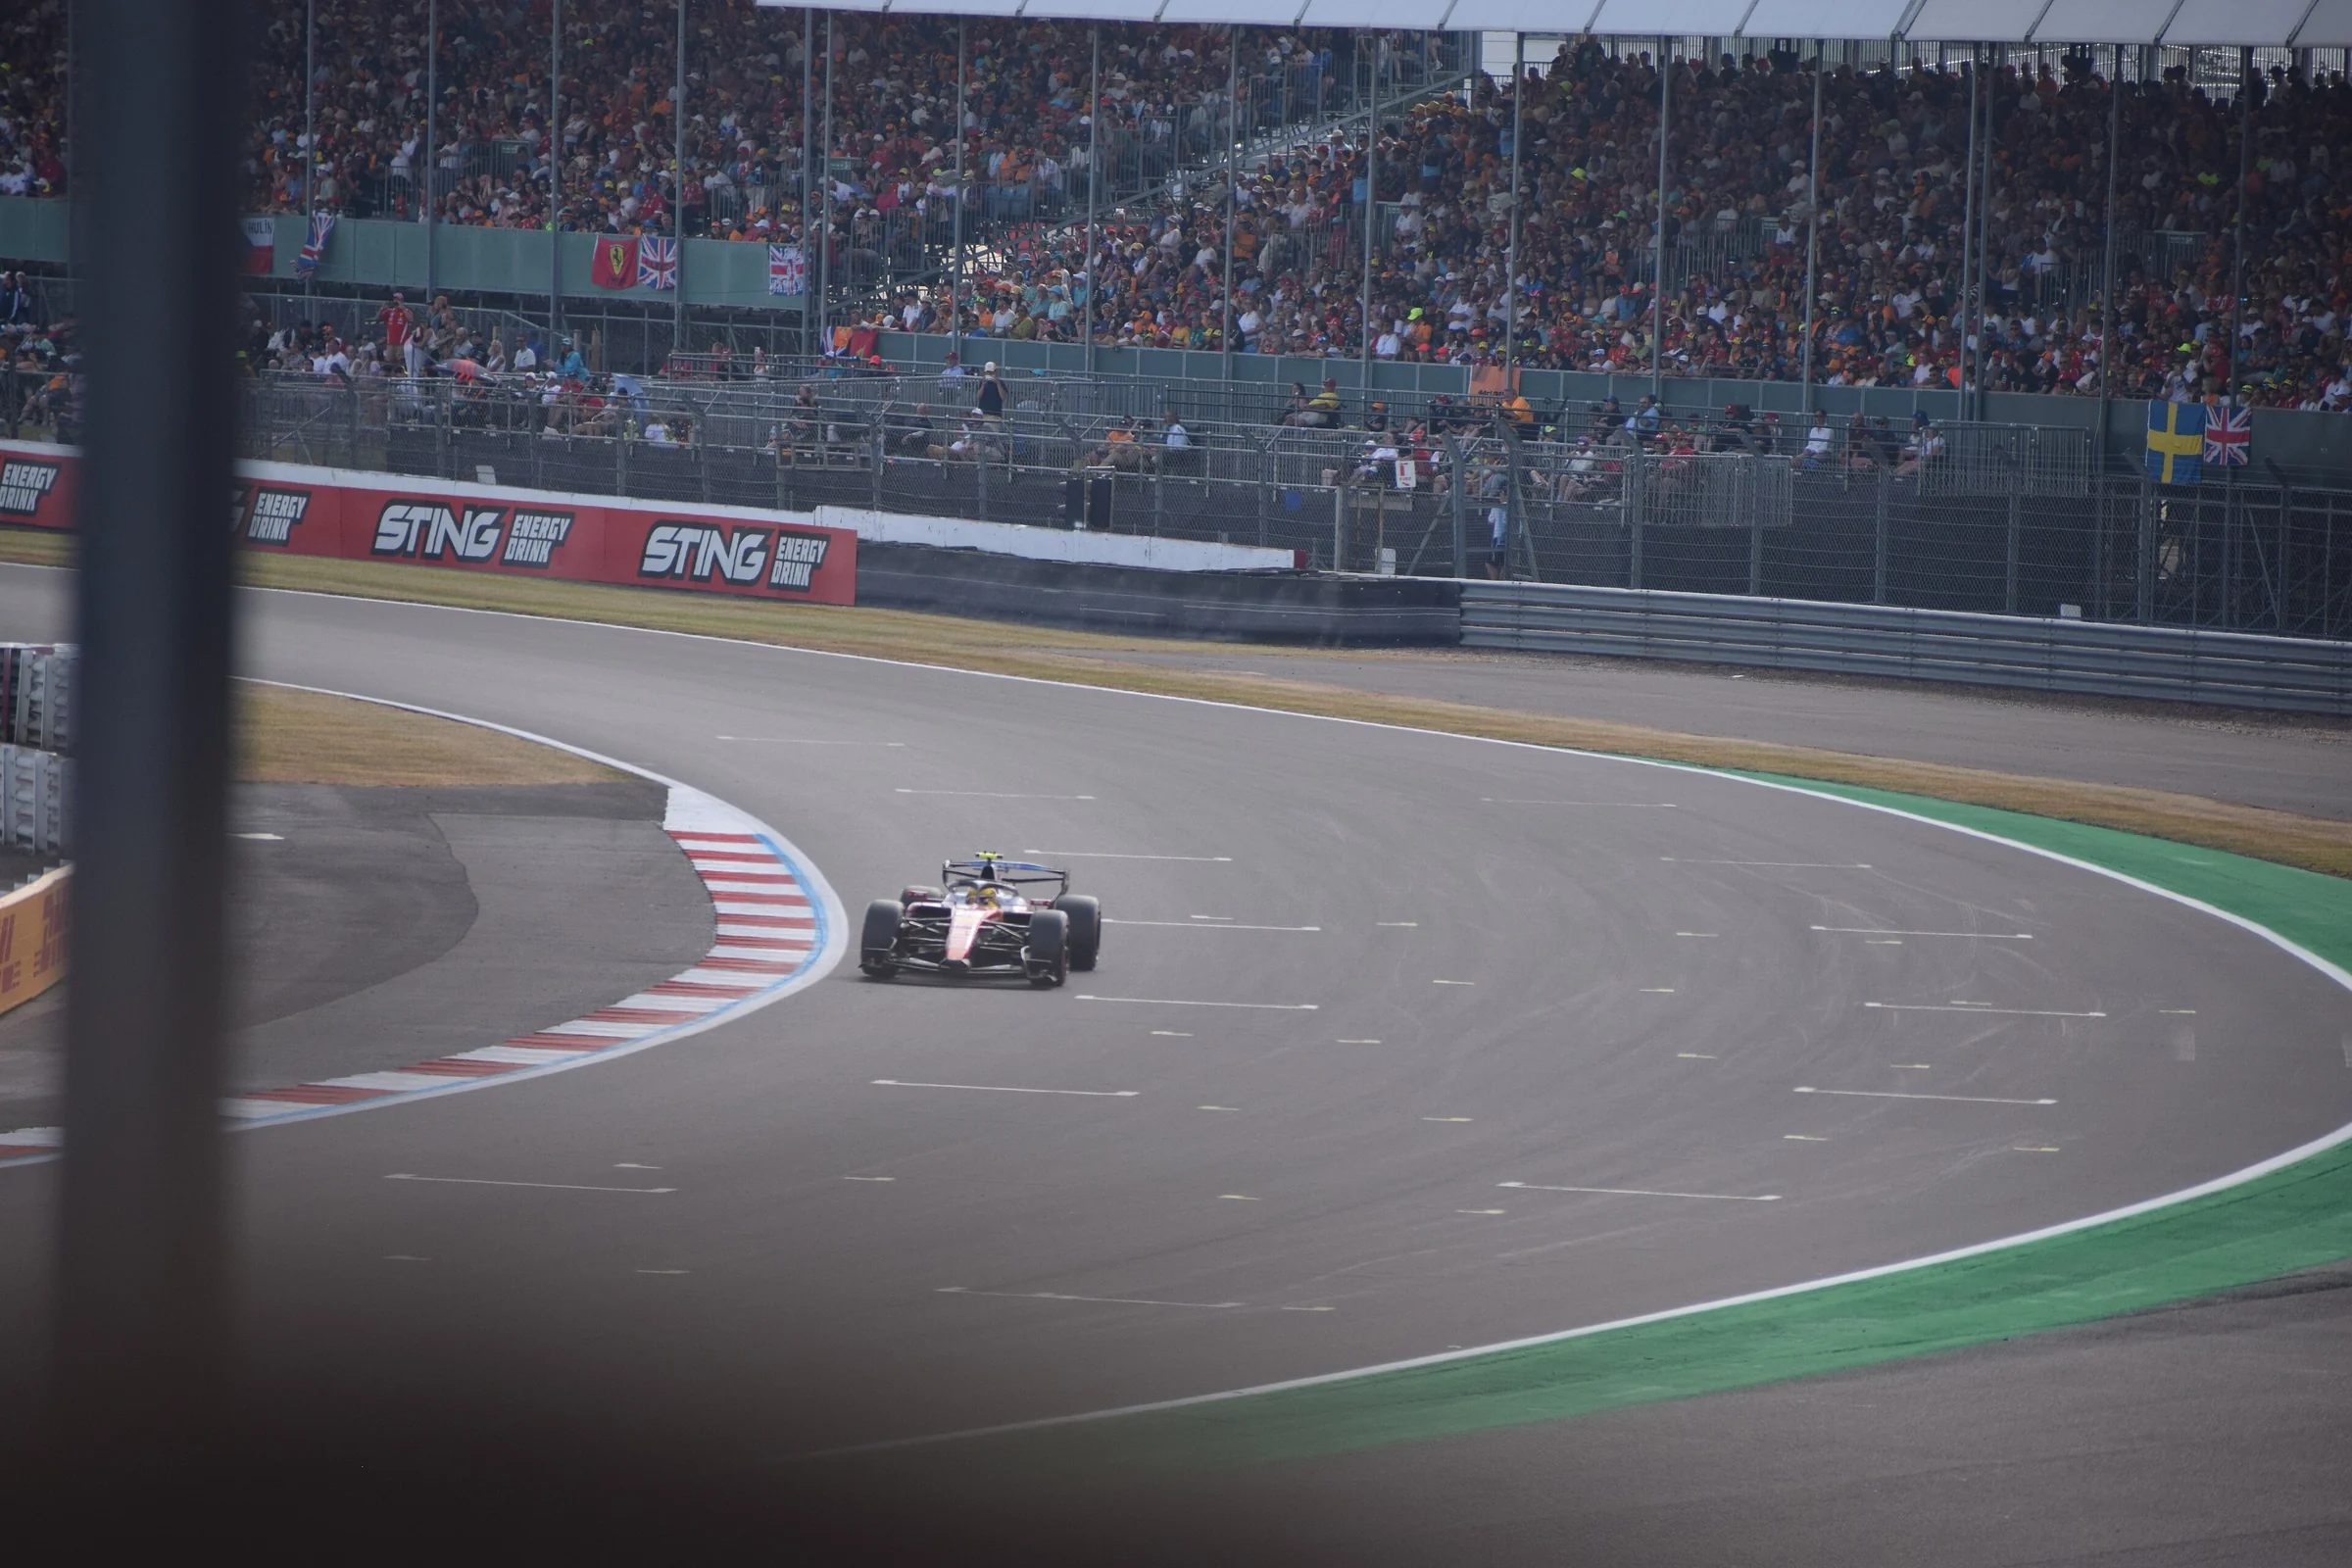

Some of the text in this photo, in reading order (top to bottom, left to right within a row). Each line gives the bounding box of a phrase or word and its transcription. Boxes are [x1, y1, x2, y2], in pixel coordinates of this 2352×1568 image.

[2, 463, 58, 490] ENERGY
[0, 485, 38, 512] DRINK
[254, 492, 308, 519] ENERGY
[248, 514, 291, 541] DRINK
[374, 505, 501, 559] STING
[513, 514, 571, 542] ENERGY
[504, 537, 553, 564] DRINK
[642, 525, 766, 581] STING
[777, 536, 827, 564] ENERGY
[770, 561, 812, 587] DRINK
